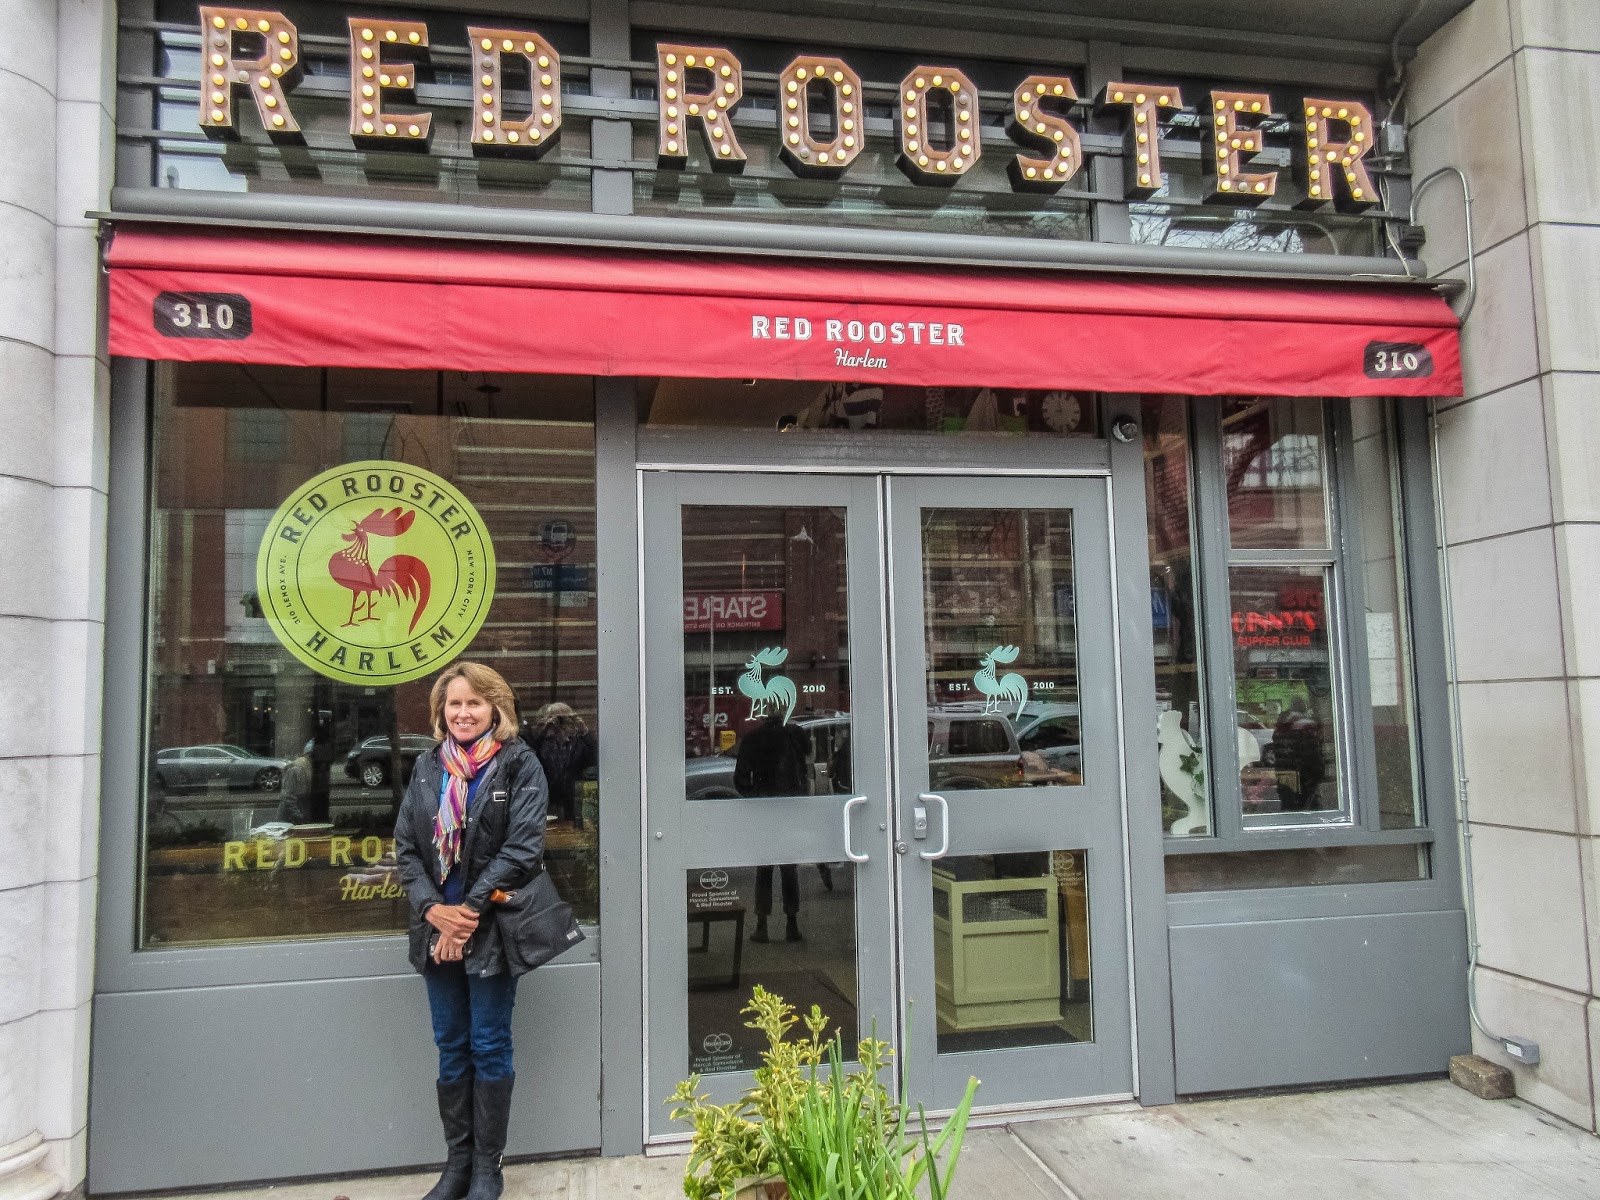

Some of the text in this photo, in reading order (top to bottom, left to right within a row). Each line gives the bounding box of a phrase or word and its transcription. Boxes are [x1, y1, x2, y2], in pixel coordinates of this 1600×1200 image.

[199, 6, 1378, 205] RED ROOSTER
[173, 303, 234, 330] 310
[752, 315, 965, 346] RED ROOSTER
[834, 347, 888, 369] Harlem
[1374, 351, 1418, 372] 310
[280, 474, 472, 544] RED ROOSTER
[279, 579, 292, 608] LENOX
[458, 550, 475, 618] NEW YORK CITY
[289, 610, 301, 625] 310
[306, 624, 455, 672] HARLEM
[1237, 635, 1311, 646] SUPPER CLUB
[711, 684, 826, 695] EST. 2010
[949, 681, 1055, 691] EST. 2010
[223, 836, 397, 872] RED RO
